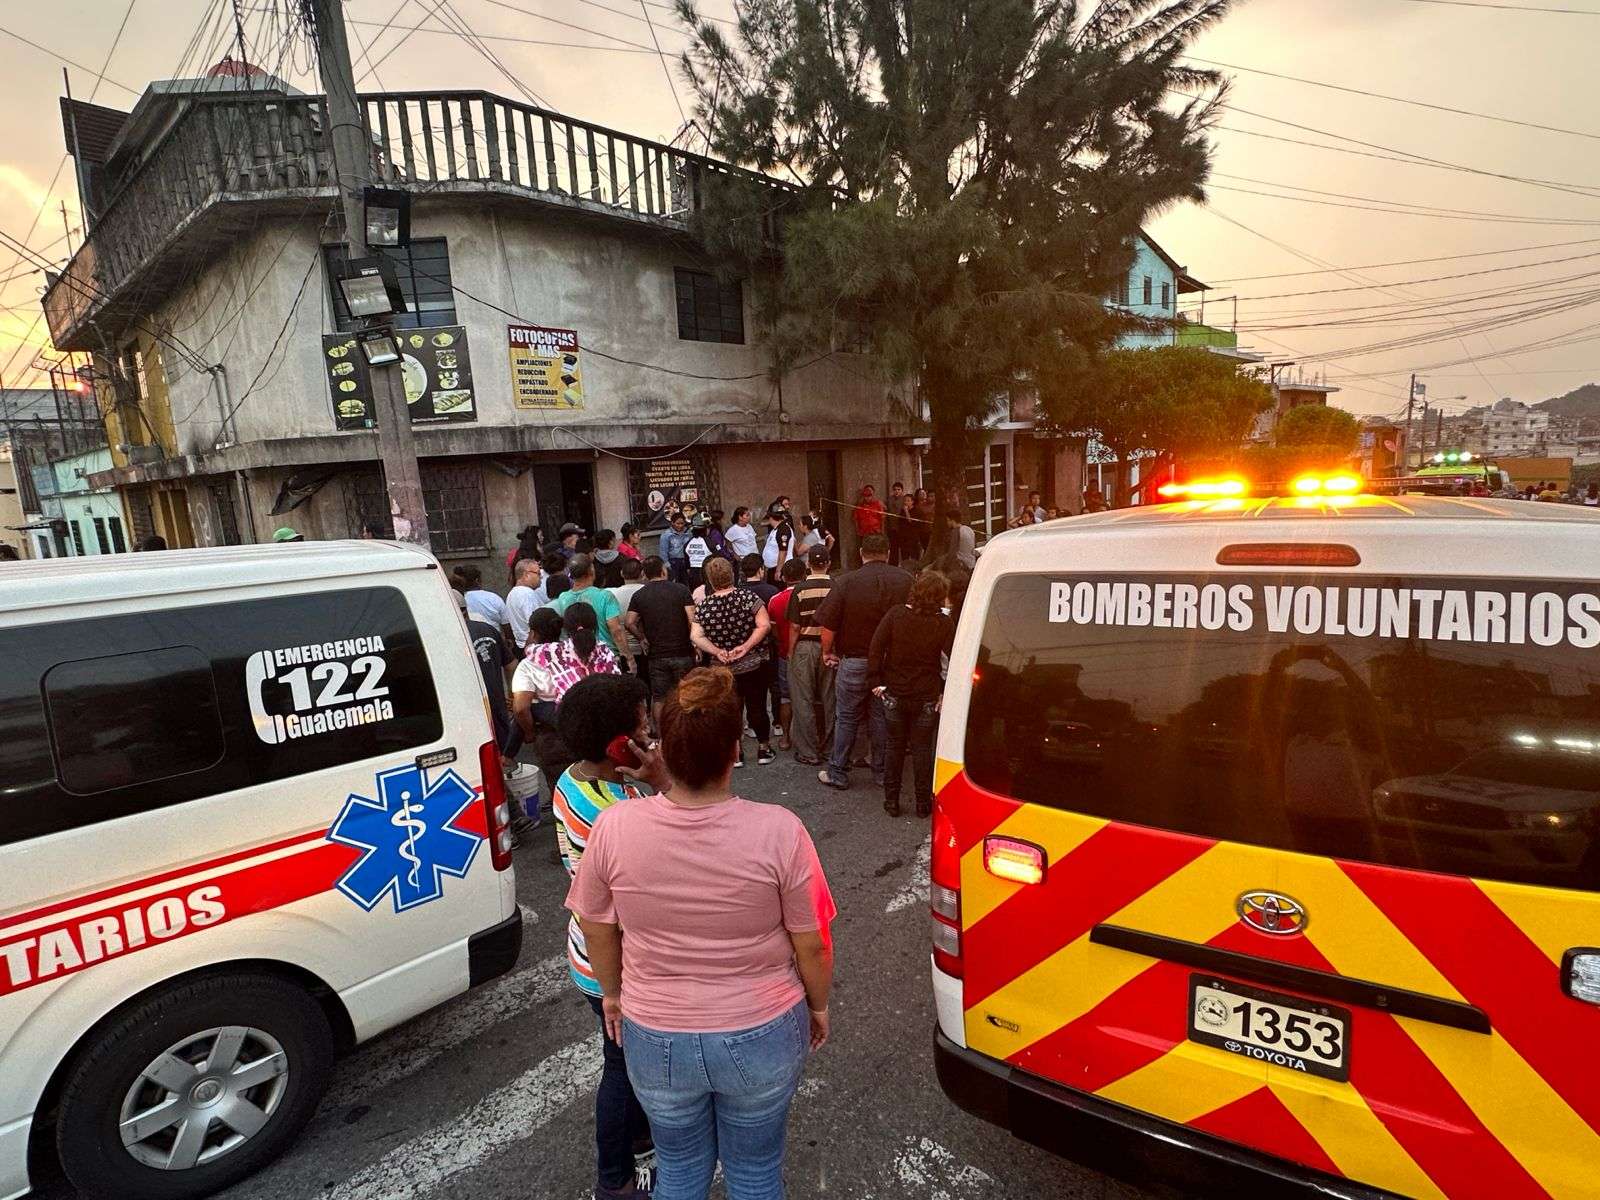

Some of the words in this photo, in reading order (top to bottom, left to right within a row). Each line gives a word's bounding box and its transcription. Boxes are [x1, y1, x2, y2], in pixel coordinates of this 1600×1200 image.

[509, 328, 575, 347] FOTOCOPIAS
[528, 343, 536, 357] Y
[1048, 581, 1254, 632] BOMBEROS
[1263, 585, 1600, 648] VOLUNTARIOS
[274, 635, 385, 667] EMERGENCIA
[278, 655, 390, 711] 122
[286, 698, 394, 739] Guatemala
[0, 885, 226, 987] TARIOS
[1232, 1001, 1342, 1061] 1353
[1243, 1044, 1307, 1072] TOYOTA
